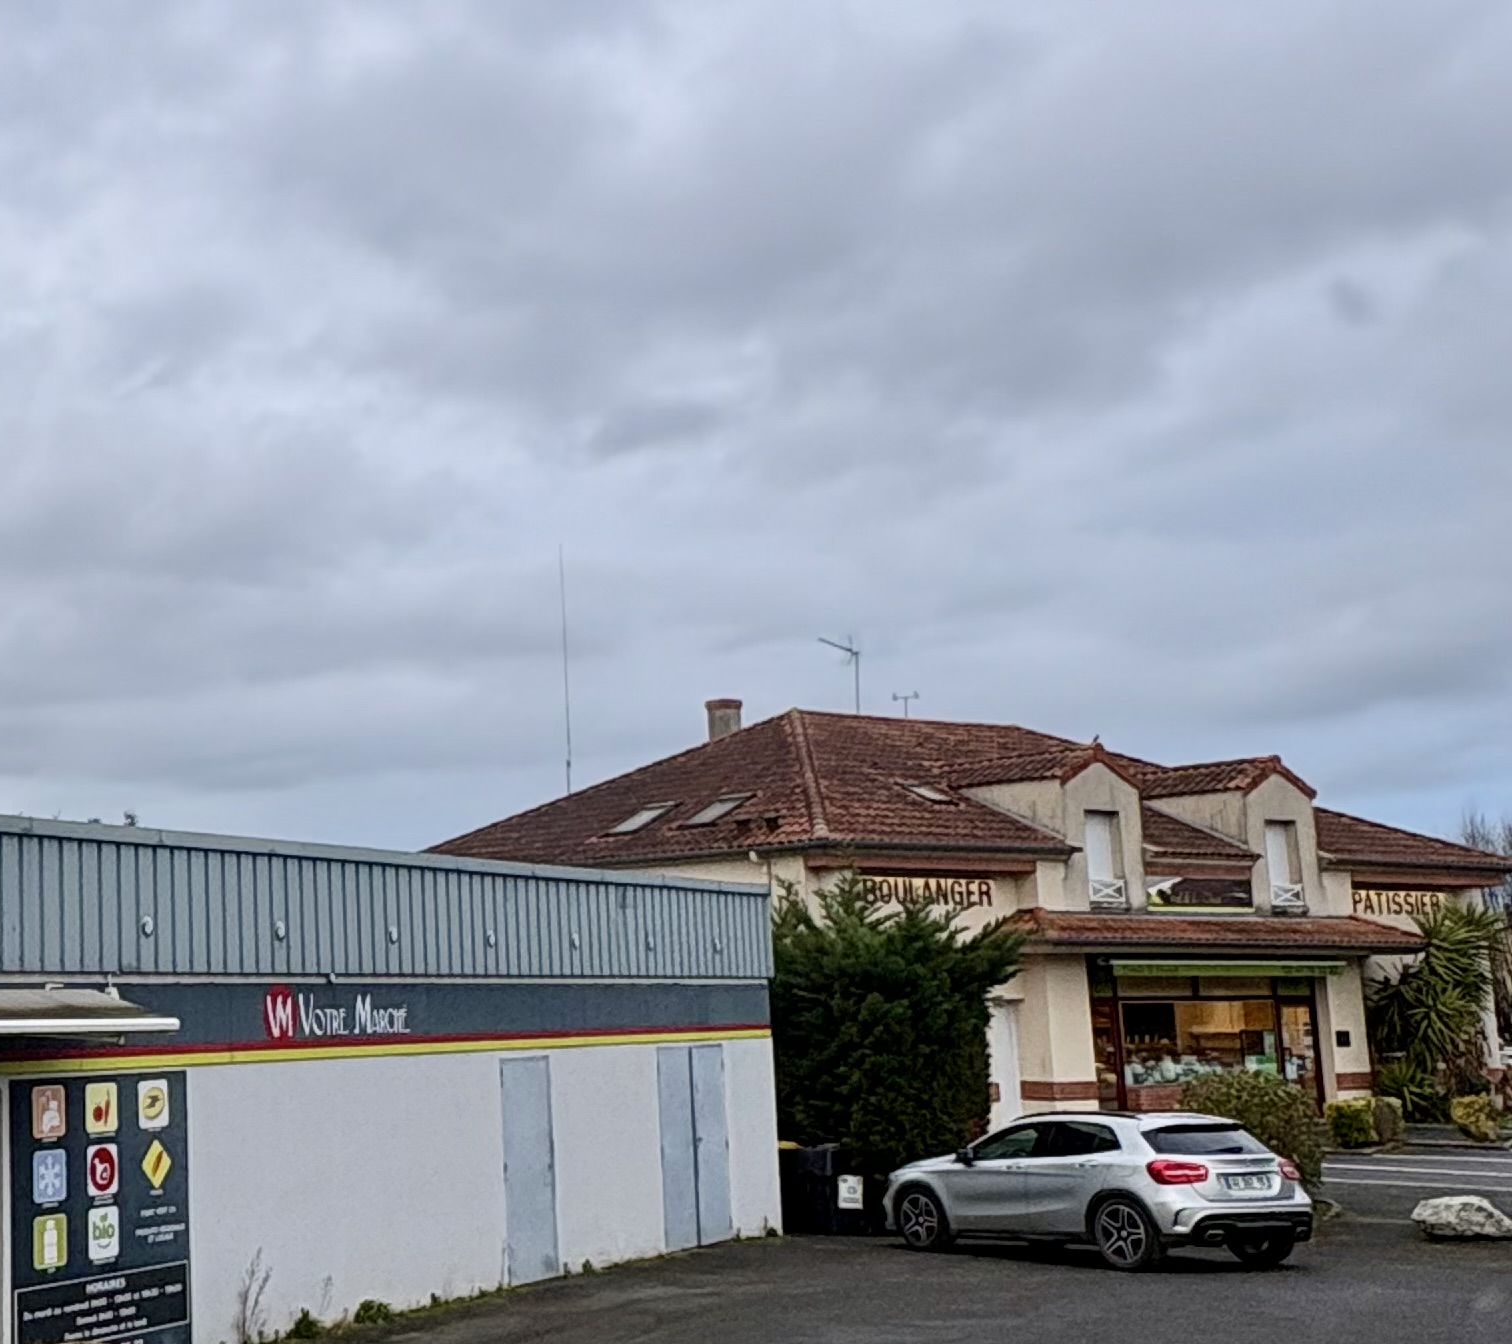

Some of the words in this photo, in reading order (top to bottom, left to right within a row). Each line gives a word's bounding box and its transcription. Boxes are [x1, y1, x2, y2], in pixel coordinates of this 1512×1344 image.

[862, 877, 993, 907] BOULANGER
[298, 992, 350, 1037] VOTRE
[92, 1220, 116, 1241] bio
